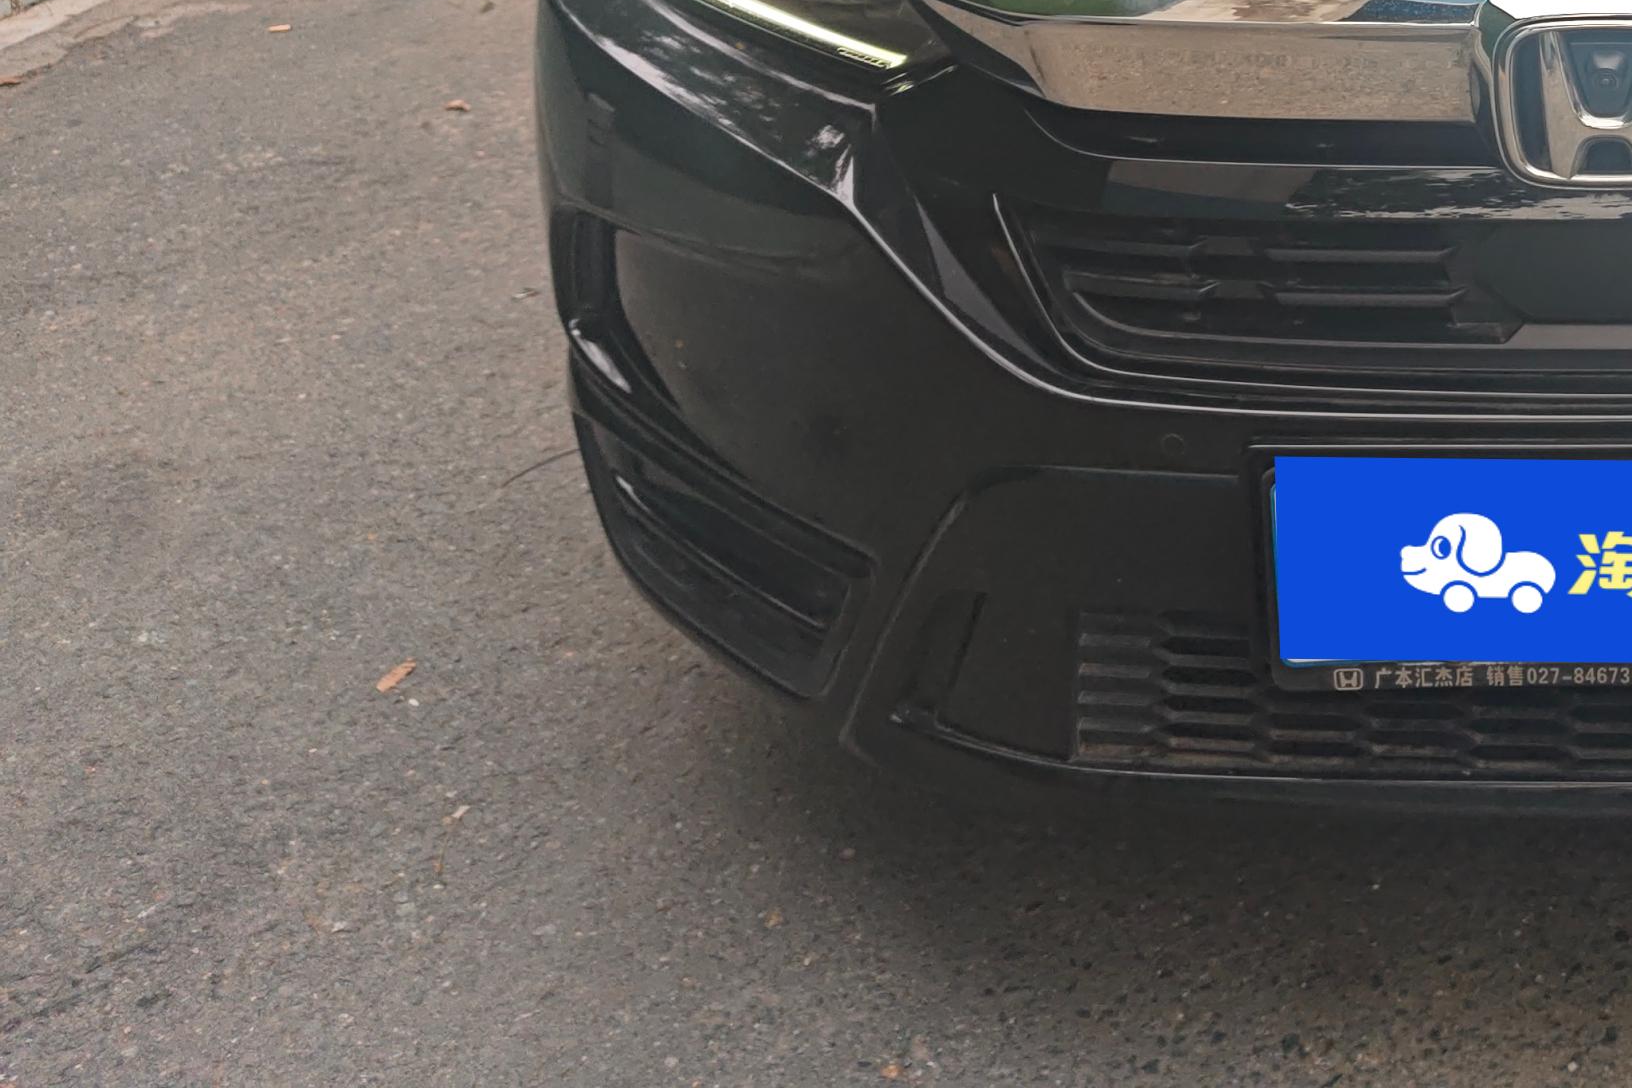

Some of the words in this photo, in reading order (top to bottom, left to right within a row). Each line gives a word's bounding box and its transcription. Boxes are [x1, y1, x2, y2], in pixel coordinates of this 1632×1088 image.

[1373, 666, 1474, 689] 广本汇杰店
